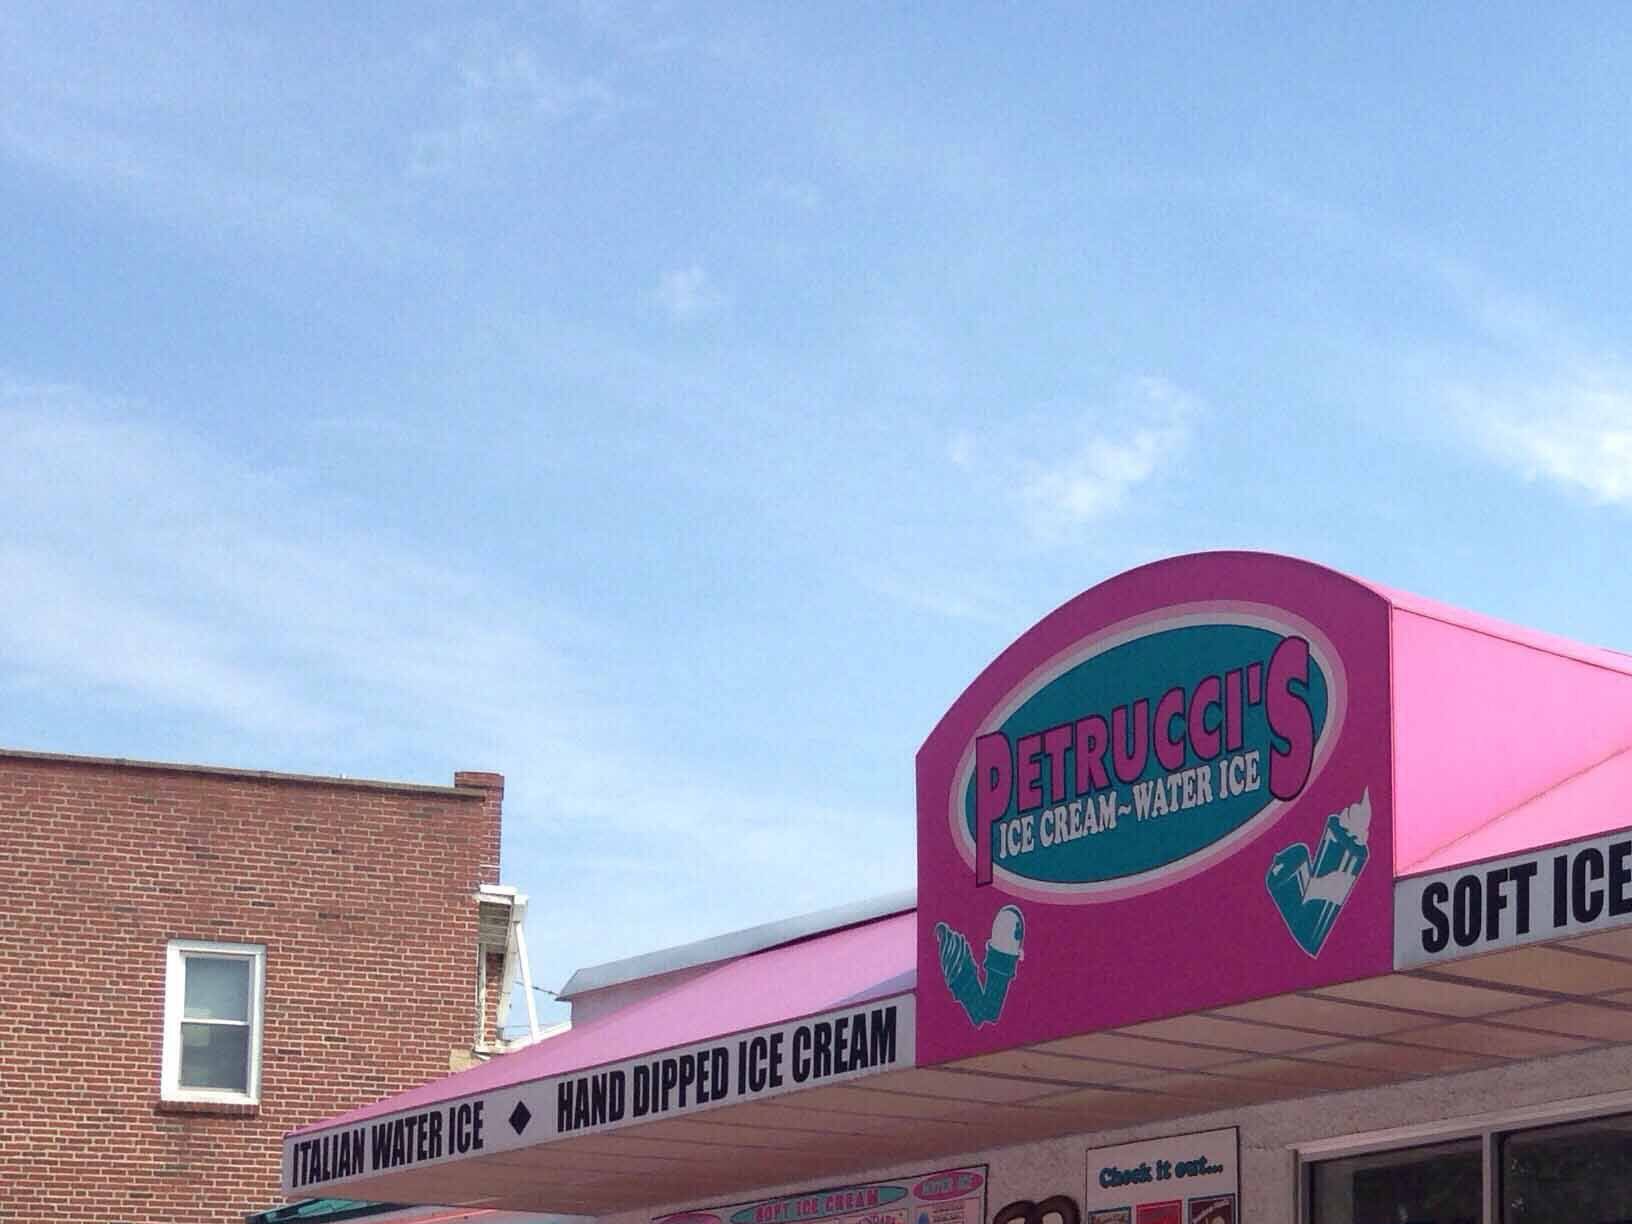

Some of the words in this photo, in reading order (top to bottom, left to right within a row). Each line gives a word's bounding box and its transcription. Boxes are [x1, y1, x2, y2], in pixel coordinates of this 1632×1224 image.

[976, 635, 1315, 887] PETRUCCI'S
[999, 816, 1034, 859] ICE
[1219, 751, 1261, 800] ICE
[1421, 860, 1537, 953] SOFT
[1553, 840, 1632, 928] ICE
[558, 1071, 625, 1132] HAND
[633, 1047, 729, 1118] DIPPED
[738, 1032, 783, 1095] ICE
[792, 1006, 897, 1082] CREAM
[293, 1128, 365, 1187] ITALIAN
[372, 1111, 442, 1169] WATER
[449, 1101, 483, 1154] ICE
[1157, 1159, 1172, 1181] it
[825, 1188, 878, 1211] CREAM
